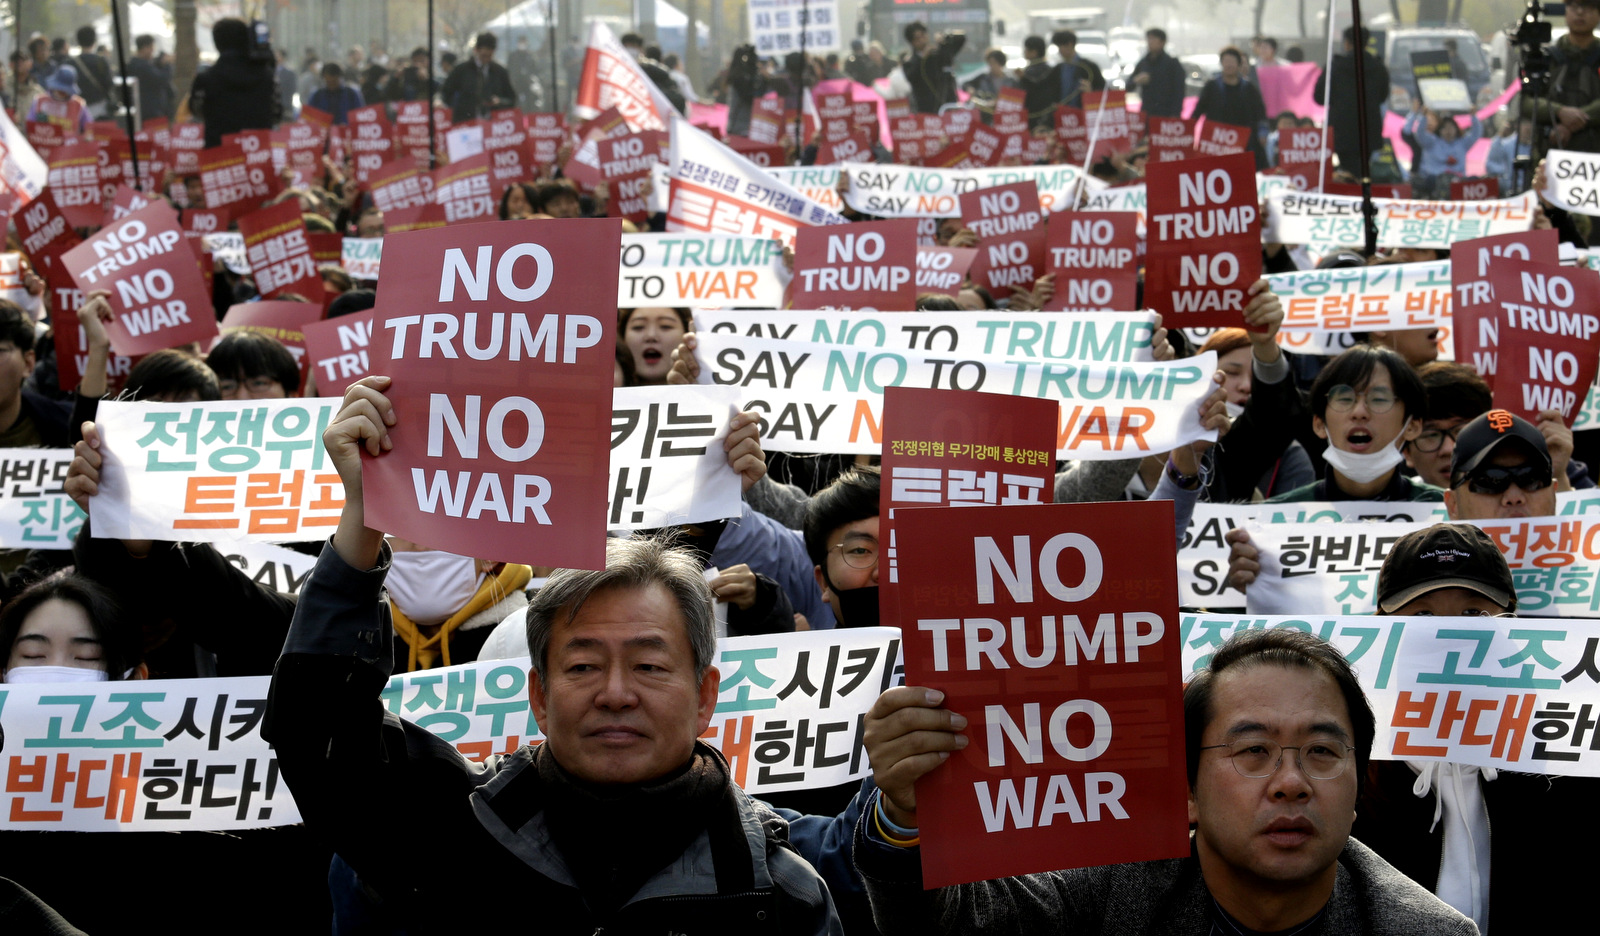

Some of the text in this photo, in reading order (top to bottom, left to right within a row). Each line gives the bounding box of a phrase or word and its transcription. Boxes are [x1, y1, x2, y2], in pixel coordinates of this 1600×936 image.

[826, 96, 845, 107] NO
[358, 123, 382, 139] NO
[492, 120, 515, 136] NO
[951, 112, 972, 124] NO
[1062, 114, 1078, 127] NO
[1160, 121, 1186, 136] NO
[352, 138, 391, 151] TRUMP
[402, 135, 431, 146] TRUM
[485, 133, 526, 149] TRUMP
[612, 137, 643, 160] NO
[832, 140, 857, 158] NO
[1151, 134, 1194, 148] TRUMP
[1213, 127, 1239, 146] NO
[1292, 131, 1320, 149] NO
[357, 154, 382, 170] NO
[494, 150, 519, 166] NO
[602, 154, 658, 178] TRUMP
[1556, 160, 1600, 181] SAY
[49, 165, 99, 188] 트럼프
[436, 174, 491, 204] 트럼프
[678, 159, 807, 216] 전쟁위협 무기강매
[789, 169, 842, 187] TRU
[856, 171, 899, 191] SAY
[904, 171, 943, 193] NO
[952, 177, 979, 194] TO
[1179, 168, 1232, 208] NO
[866, 195, 955, 214] SAY NO
[979, 189, 1020, 217] NO
[1282, 194, 1366, 216] 한반도
[1463, 184, 1488, 198] NO
[1567, 187, 1599, 208] SA
[24, 202, 49, 233] NO
[192, 213, 218, 231] NO
[966, 211, 1040, 238] TRUMP
[1153, 205, 1256, 241] TRUMP
[23, 215, 66, 255] TRUMP
[92, 219, 147, 258] NO
[1070, 219, 1115, 246] NO
[80, 229, 180, 284] TRUMP
[250, 228, 311, 272] 트럼프
[657, 238, 784, 267] TRUMP
[826, 231, 886, 264] NO
[916, 251, 953, 271] NO
[988, 241, 1029, 267] NO
[1051, 247, 1134, 269] TRUMP
[438, 242, 554, 303] NO
[800, 266, 911, 293] TRUMP
[915, 269, 962, 290] UMP
[987, 265, 1034, 289] WAR
[1180, 251, 1240, 287] NO
[115, 268, 174, 309] NO
[624, 270, 758, 300] TO WAR
[1068, 278, 1113, 306] NO
[1520, 271, 1575, 308] NO
[1171, 289, 1244, 313] WAR
[1280, 293, 1391, 330] 트럼프
[120, 299, 191, 337] WAR
[1501, 302, 1599, 341] TRUMP
[337, 318, 374, 352] N
[384, 312, 603, 364] TRUMP
[811, 319, 886, 347] NO
[901, 324, 959, 352] TO
[975, 320, 1155, 364] TRUMP
[712, 347, 1203, 401] SAY NO TO TRUMP
[1528, 346, 1579, 386] NO
[1522, 383, 1577, 418] WAR
[427, 393, 545, 463] NO
[743, 399, 837, 441] SAY
[848, 399, 884, 443] N
[136, 405, 332, 473] 전쟁위
[891, 439, 1049, 467] 전쟁위협 무기강매 통상압력
[173, 469, 347, 535] 트럼프
[411, 468, 553, 526] WAR
[973, 532, 1103, 605] NO
[917, 611, 1165, 672] TRUMP
[704, 638, 906, 709] 조시키
[984, 698, 1113, 768] NO
[1390, 690, 1600, 763] 반대한
[5, 752, 280, 824] 반대한다!
[973, 771, 1131, 834] WAR
